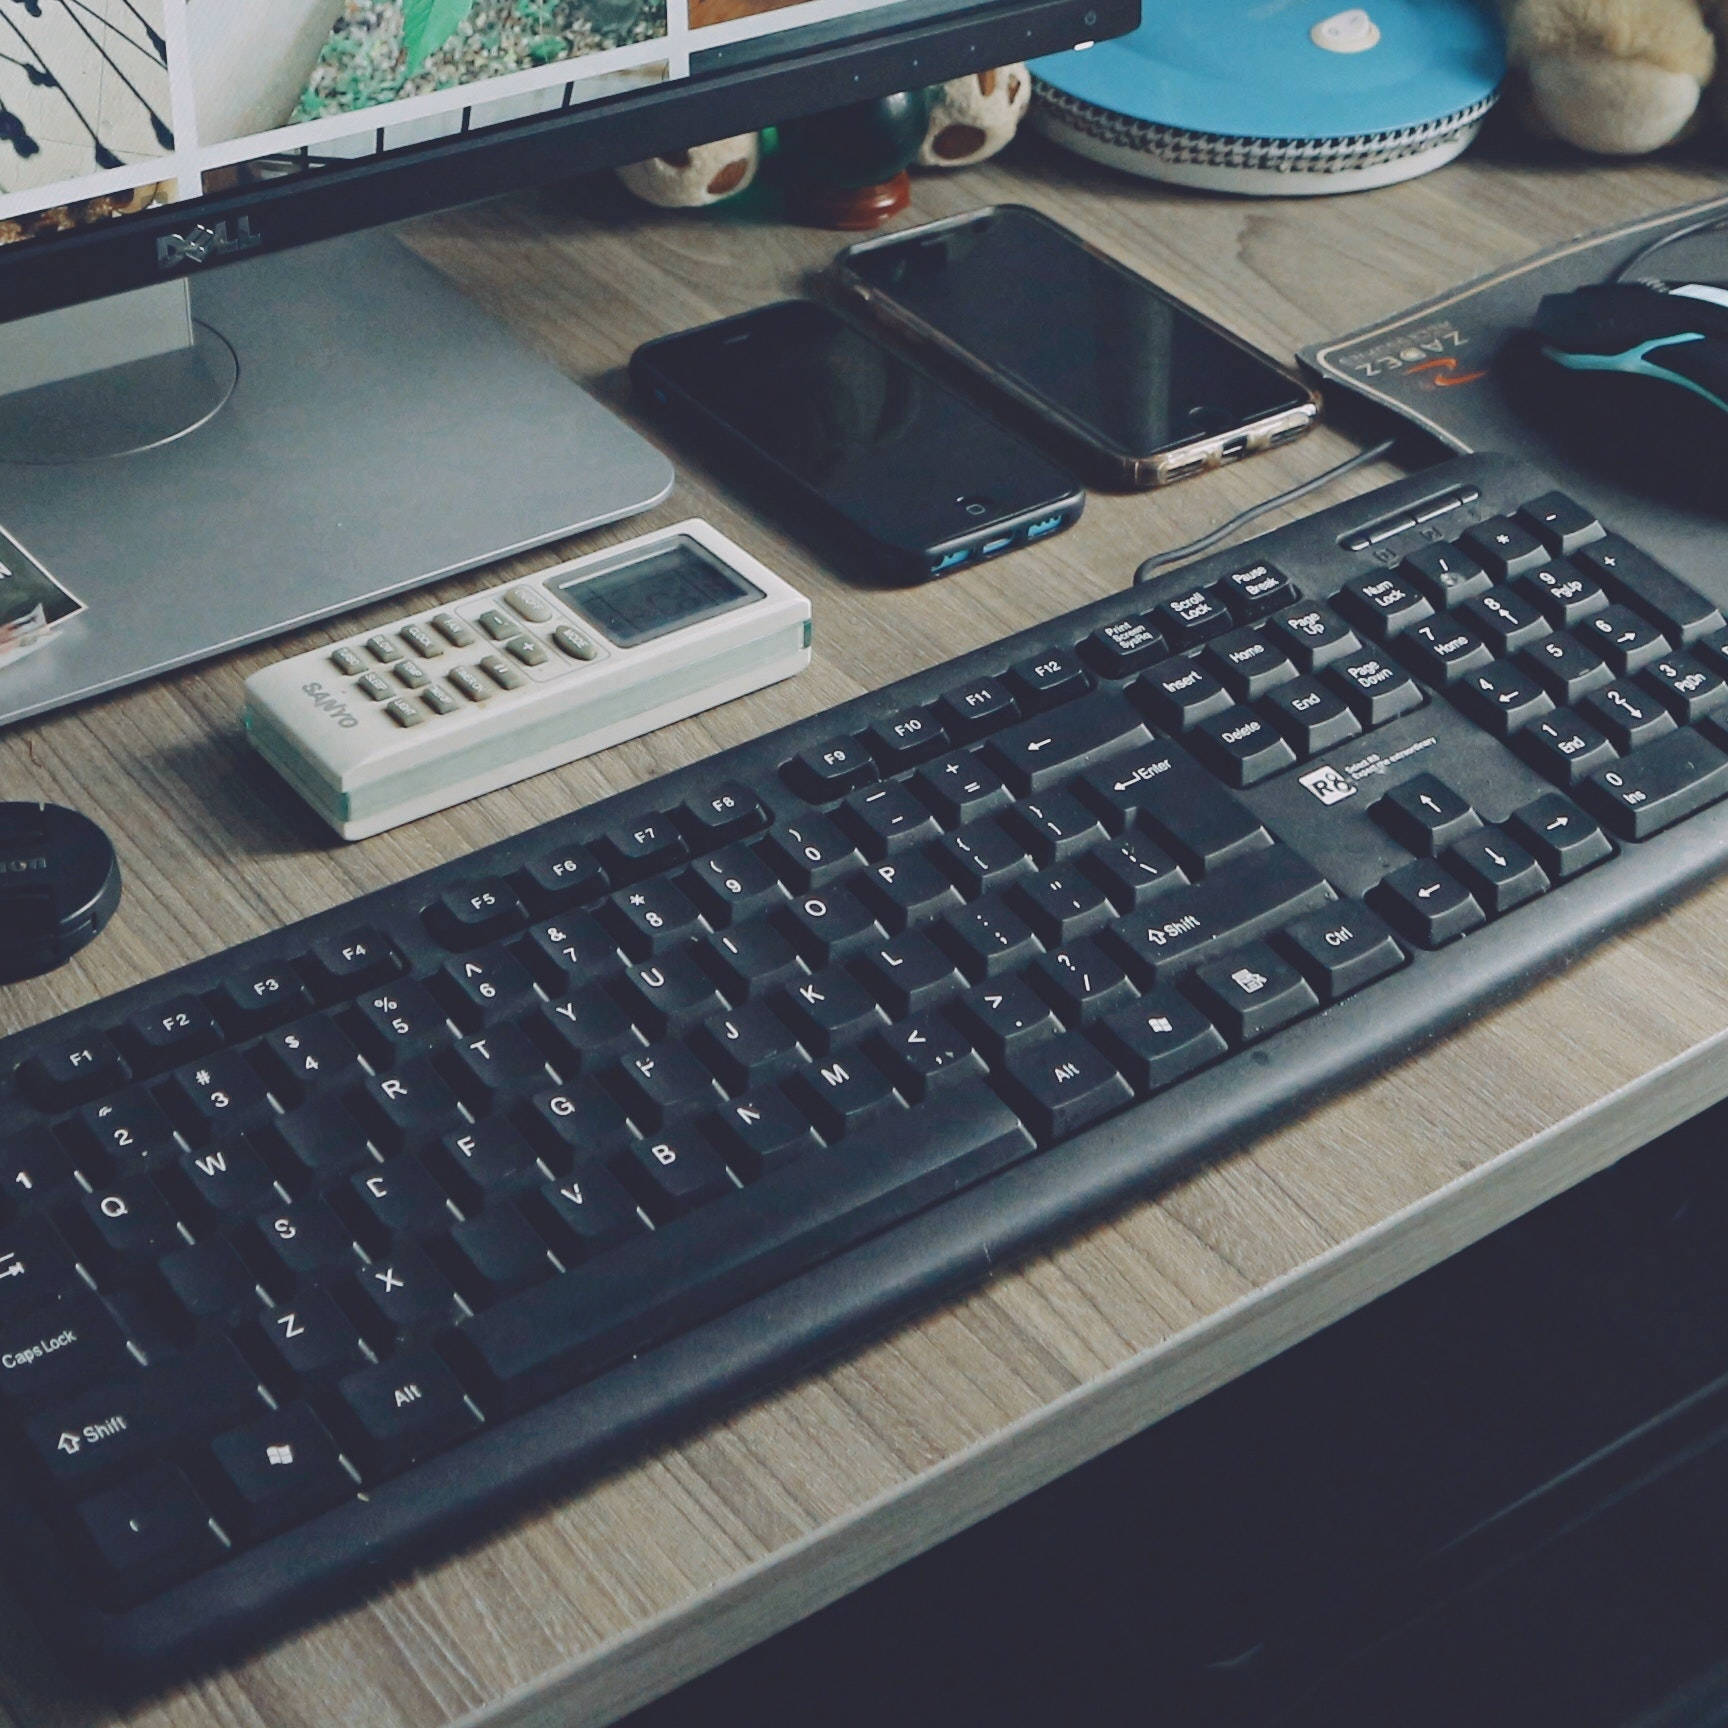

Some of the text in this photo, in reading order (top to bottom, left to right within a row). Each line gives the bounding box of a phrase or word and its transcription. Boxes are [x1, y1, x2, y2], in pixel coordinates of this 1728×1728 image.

[1232, 566, 1266, 584] Pause
[1539, 572, 1556, 585] 9
[1245, 577, 1280, 595] Break
[1363, 581, 1393, 597] Num
[1550, 580, 1583, 599] PgUp
[1171, 592, 1205, 611] Scroll
[1375, 588, 1406, 607] Lock
[1484, 598, 1500, 610] 8
[1181, 604, 1212, 621] Lock
[1288, 613, 1321, 630] Page
[1105, 622, 1131, 636] Print
[1113, 625, 1145, 643] Screen
[1304, 624, 1325, 636] Up
[1418, 626, 1435, 641] 7
[1595, 619, 1613, 633] 6
[1228, 644, 1265, 664] Home
[1433, 636, 1469, 656] Home
[1546, 643, 1563, 658] 5
[1034, 660, 1062, 677] F12
[1348, 661, 1379, 678] Page
[1659, 664, 1677, 677] 3
[1162, 670, 1203, 693] Insert
[1358, 669, 1393, 688] Down
[1479, 678, 1494, 690] 4
[1673, 673, 1707, 693] PgDn
[302, 682, 358, 728] SANYO
[965, 690, 992, 706] F11
[1291, 692, 1321, 711] End
[1607, 691, 1624, 704] 2
[894, 719, 922, 737] F10
[1221, 721, 1261, 744] Delete
[1542, 723, 1558, 737] 1
[1557, 735, 1586, 754] End
[823, 750, 846, 765] F9
[1137, 759, 1172, 780] Enter
[1605, 772, 1623, 786] 0
[712, 796, 735, 812] F8
[1622, 790, 1647, 805] Ins
[634, 827, 655, 844] F7
[552, 860, 577, 876] F6
[878, 866, 895, 884] P
[725, 879, 742, 893] 9
[470, 893, 496, 910] F5
[804, 899, 827, 917] O
[645, 912, 663, 927] 8
[1163, 915, 1201, 937] Shift
[1325, 926, 1353, 946] Ctrl
[342, 944, 366, 961] F4
[253, 978, 280, 996] F3
[479, 982, 496, 998] 6
[799, 984, 825, 1004] K
[162, 1013, 190, 1031] F2
[392, 1018, 409, 1034] 5
[69, 1049, 93, 1067] F1
[820, 1063, 850, 1086] M
[1054, 1062, 1080, 1083] Alt
[381, 1079, 408, 1100] R
[550, 1096, 576, 1116] G
[194, 1151, 227, 1176] W
[651, 1144, 676, 1165] B
[100, 1196, 129, 1218] Q
[274, 1218, 296, 1239] S
[375, 1268, 404, 1293] X
[277, 1313, 305, 1338] Z
[1, 1330, 77, 1369] Caps Lock
[394, 1384, 422, 1408] Alt
[82, 1416, 127, 1443] Shift
